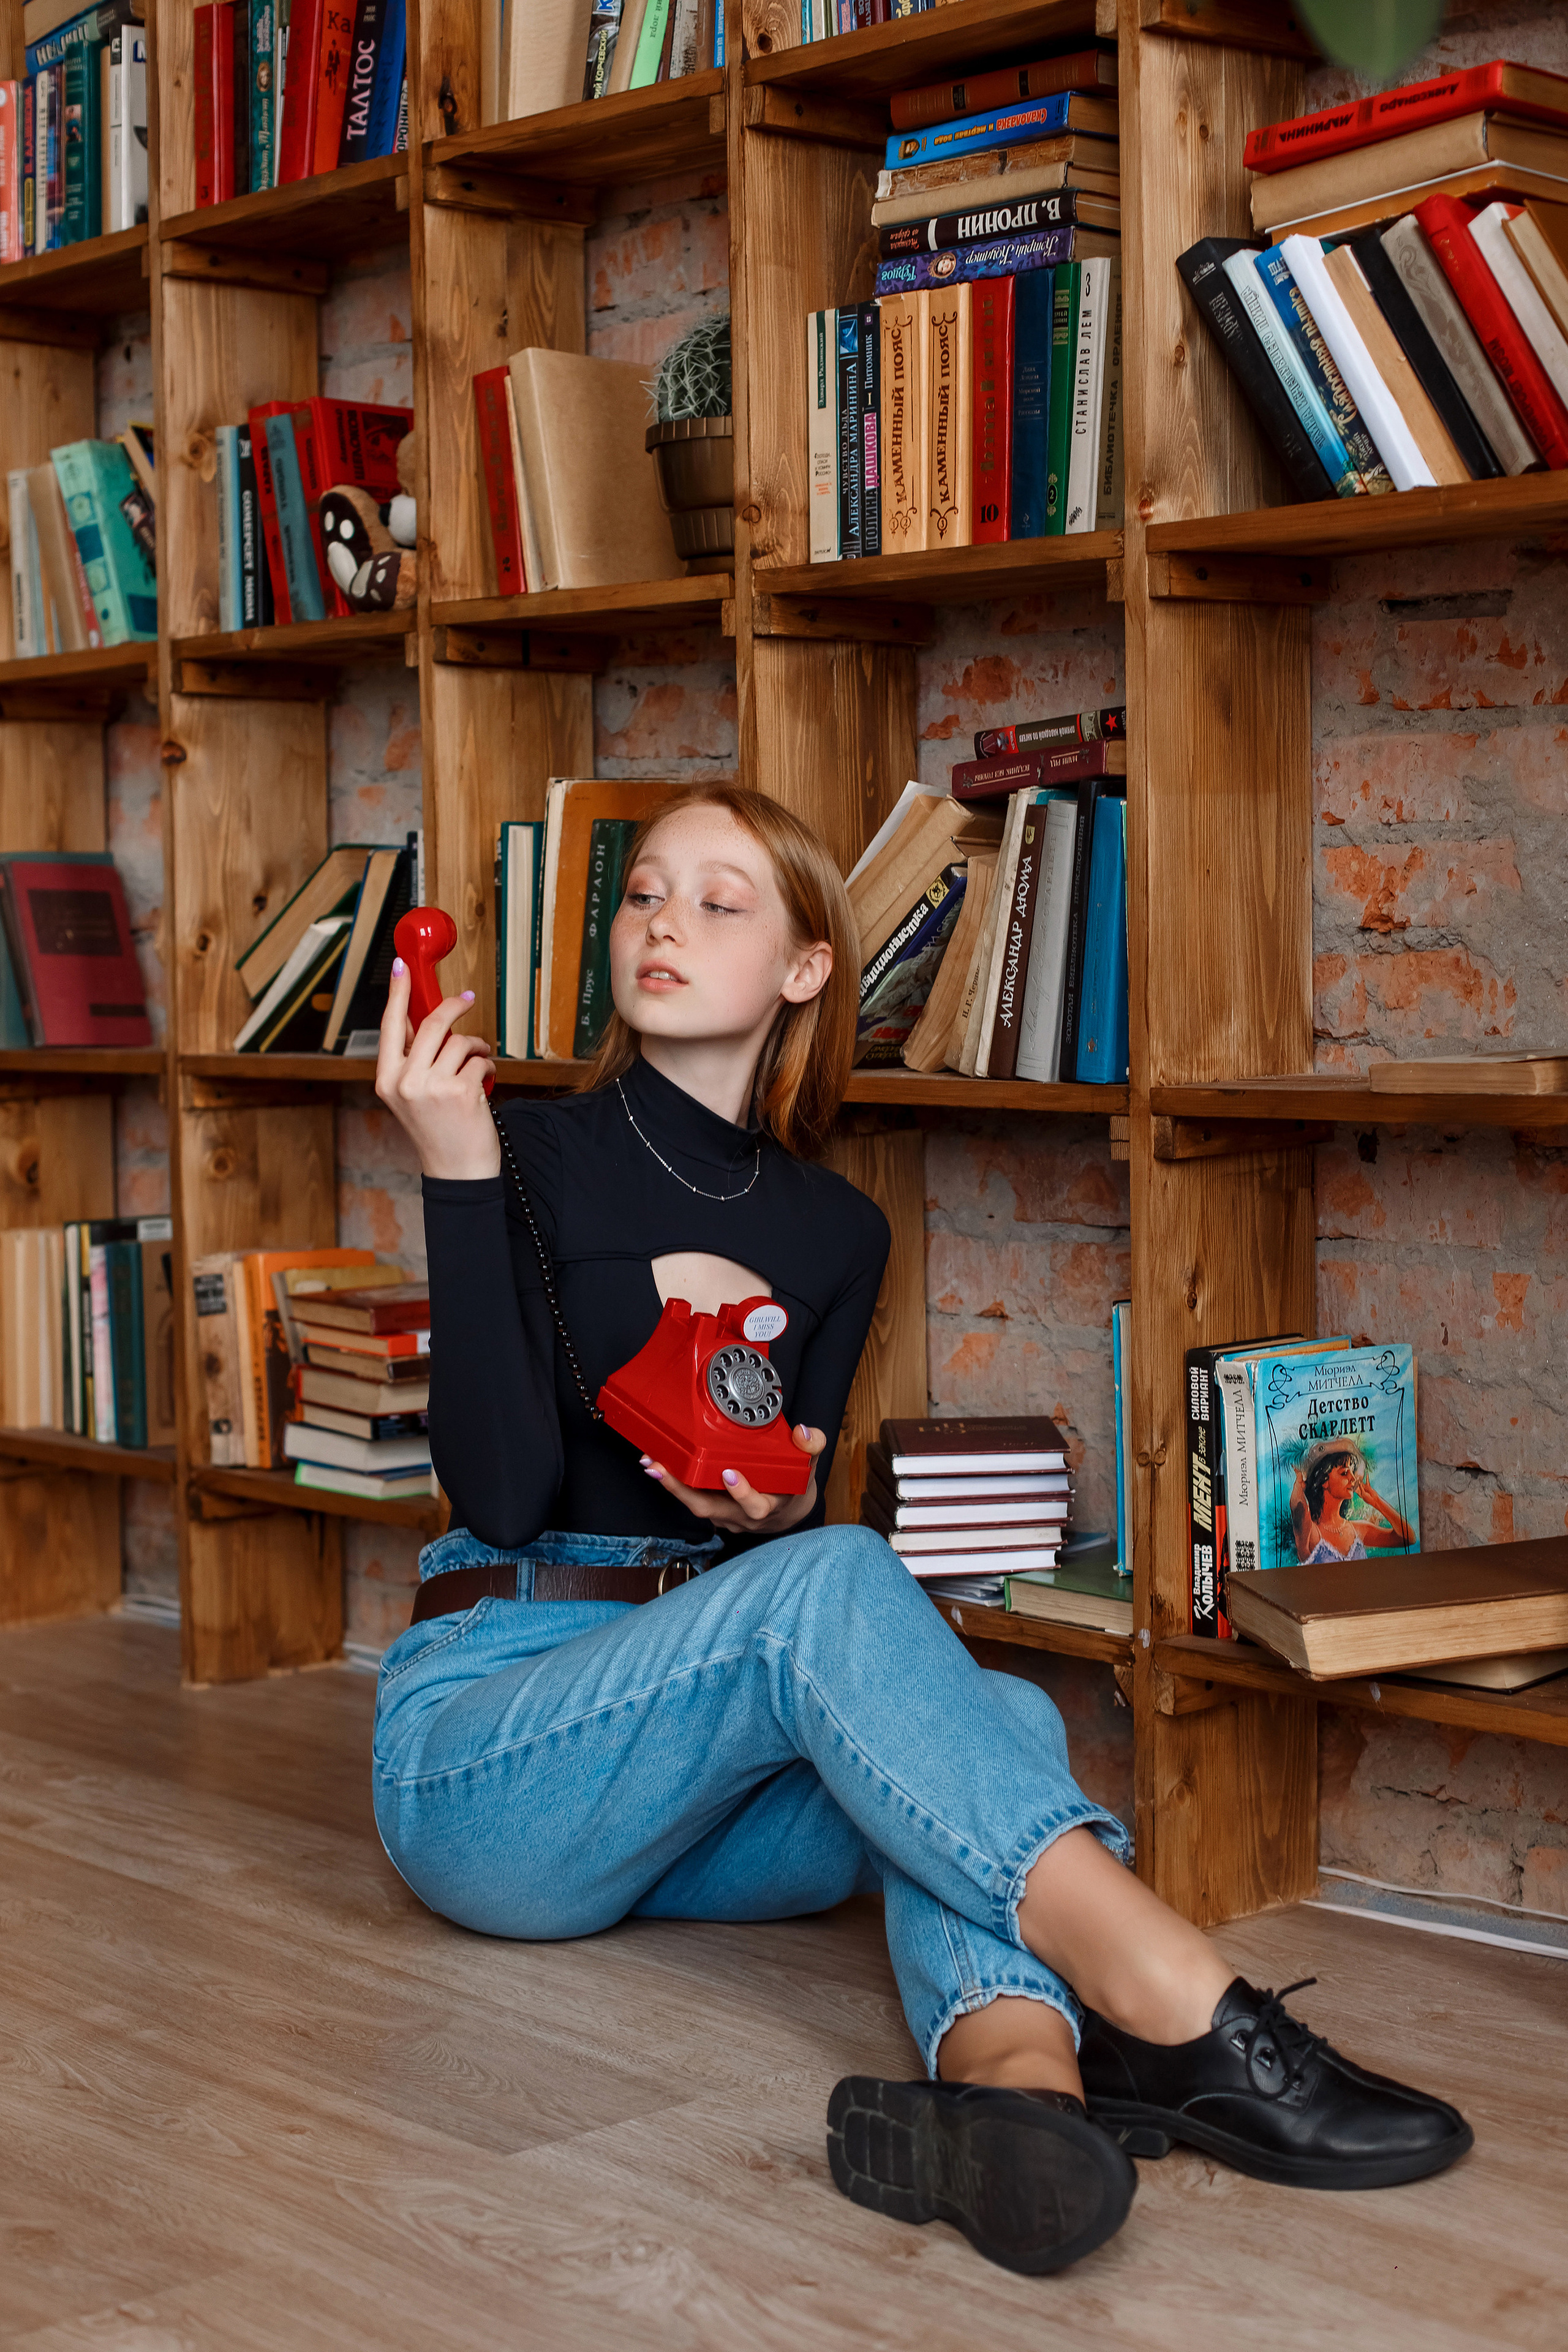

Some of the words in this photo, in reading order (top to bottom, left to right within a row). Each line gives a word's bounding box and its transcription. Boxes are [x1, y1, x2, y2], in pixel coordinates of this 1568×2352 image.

[649, 15, 659, 38] лорд
[595, 30, 608, 81] КОРЧЕВСКИЙ
[1379, 81, 1459, 112] Александра
[954, 125, 987, 141] мертвая
[996, 108, 1047, 131] Скалолазка
[1279, 113, 1354, 143] МАРИНИНА
[934, 134, 952, 146] вода
[957, 202, 1038, 239] ПРОНИН
[1041, 197, 1061, 220] В.
[966, 244, 1014, 265] Коултер
[1016, 235, 1058, 257] Кэтрин
[881, 263, 917, 282] Герцог
[1085, 273, 1091, 296] 3
[1081, 309, 1091, 339] ЛЕМ
[1240, 284, 1270, 333] ПРИНЦА
[864, 333, 873, 390] Питомник
[891, 328, 905, 381] ПОЯС
[938, 324, 951, 379] ПОЯС
[1262, 331, 1309, 409] ИСЧЕЗНУВШЕГО
[1075, 349, 1090, 435] СТАНИСЛАВ
[1310, 337, 1357, 423] Сладостная
[846, 362, 858, 442] МАРИНИНА
[891, 385, 907, 503] КАМЕННЫЙ
[937, 383, 951, 504] КАМЕННЫЙ
[1104, 380, 1118, 496] БИБЛИОТЕЧКА
[1301, 406, 1326, 450] ТАЙНА
[864, 412, 880, 489] ДАШКОВА
[848, 448, 859, 537] АЛЕКСАНДРА
[1049, 490, 1054, 499] 2
[865, 490, 878, 550] ПОЛИНА
[903, 518, 908, 529] 2
[940, 519, 946, 529] 3
[981, 503, 999, 523] 10
[1019, 733, 1033, 743] АНГЕЛУ
[1039, 728, 1060, 741] НАВОДКОЙ
[1060, 725, 1076, 737] ПРЯМОЙ
[974, 772, 994, 782] ГОЛОВЫ
[1006, 764, 1030, 775] ВСАДНИК
[1043, 835, 1057, 918] СКАРЛЕТТ
[1074, 815, 1085, 904] ПРИКЛЮЧЕНИЙ
[589, 844, 605, 937] ФАРАОН
[1000, 921, 1023, 1028] АЛЕКСАНДР
[1015, 856, 1031, 918] ДЮМА
[1069, 911, 1078, 988] БИБЛИОТЕКА
[582, 969, 594, 1005] Прус
[581, 1012, 590, 1025] Б.
[962, 1009, 968, 1019] Н.
[965, 998, 973, 1008] Г.
[1065, 993, 1074, 1044] ЗОЛОТАЯ
[1308, 1374, 1363, 1392] МИТЧЕЛЛ
[1314, 1365, 1356, 1378] Мюриэл
[1189, 1366, 1199, 1421] СИЛОВОЙ
[1200, 1368, 1209, 1421] ВАРИАНТ
[1308, 1396, 1369, 1420] Детство
[1234, 1389, 1247, 1453] МИТЧЕЛЛ
[1298, 1415, 1376, 1440] СКАРЛЕТТ
[1193, 1452, 1212, 1532] МЕНТ
[1238, 1455, 1249, 1507] Мюриэл
[1193, 1544, 1215, 1621] КОЛЫЧЕВ
